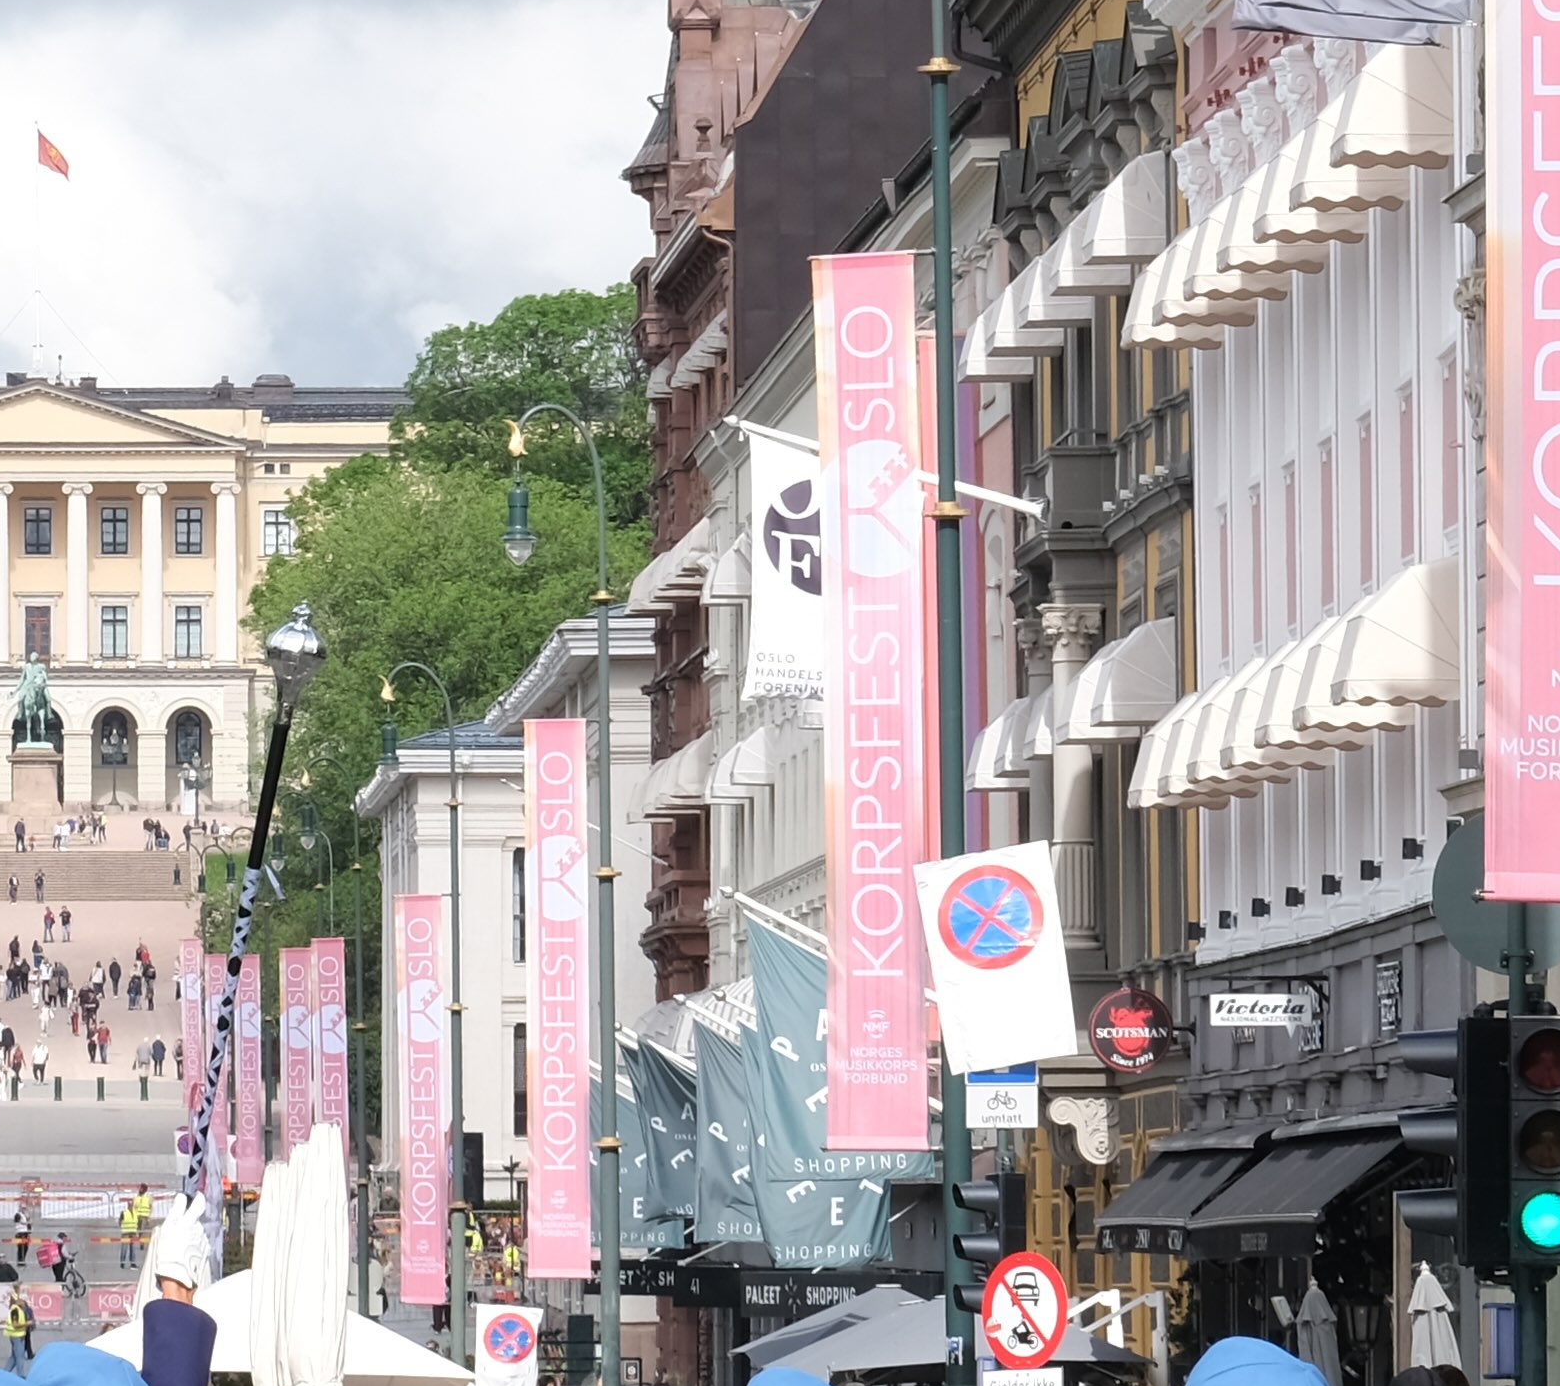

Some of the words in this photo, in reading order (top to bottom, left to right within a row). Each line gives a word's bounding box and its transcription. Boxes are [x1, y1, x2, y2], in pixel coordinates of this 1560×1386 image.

[756, 651, 796, 664] OSLO
[848, 600, 903, 977] KORPSFEST
[1215, 998, 1306, 1014] Victoria
[1095, 1027, 1168, 1039] SCOTSMAN
[541, 932, 577, 1172] KORPSFEST
[850, 1046, 903, 1058] NORGES
[835, 1059, 917, 1072] MUSIKKORPS
[844, 1072, 908, 1084] FORBUND
[241, 1039, 256, 1141] KORPSFEST
[288, 1055, 306, 1143] RPSFEST
[981, 1113, 1023, 1124] unntatt
[410, 1047, 436, 1227] KORPSFEST
[793, 1153, 908, 1174] SHOPPING
[690, 1278, 700, 1294] 41
[746, 1286, 781, 1304] PALEET
[805, 1285, 857, 1305] SHOPPING
